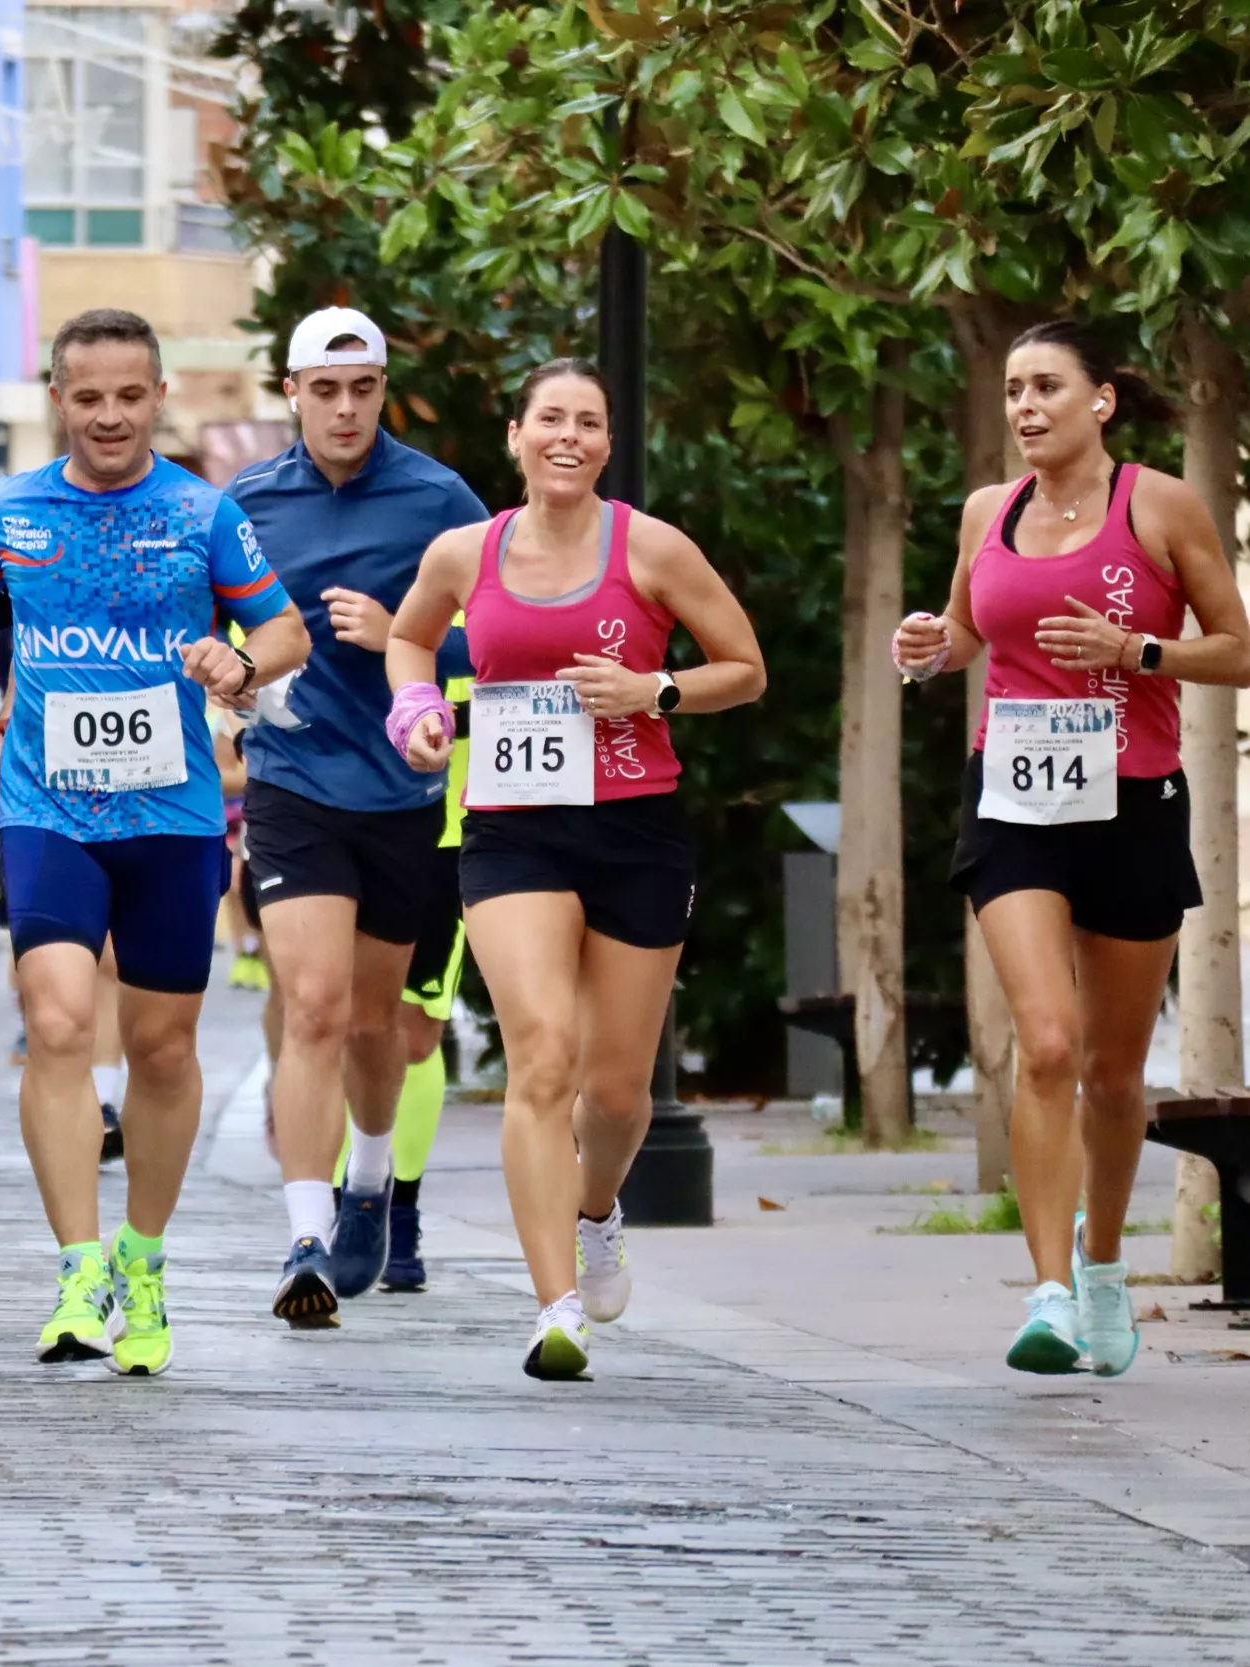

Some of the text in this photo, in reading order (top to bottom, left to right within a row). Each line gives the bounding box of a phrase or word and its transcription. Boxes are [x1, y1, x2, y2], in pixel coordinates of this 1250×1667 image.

[1, 516, 30, 529] Club
[132, 540, 177, 549] enerplus
[495, 736, 565, 773] 815
[1012, 755, 1088, 791] 814
